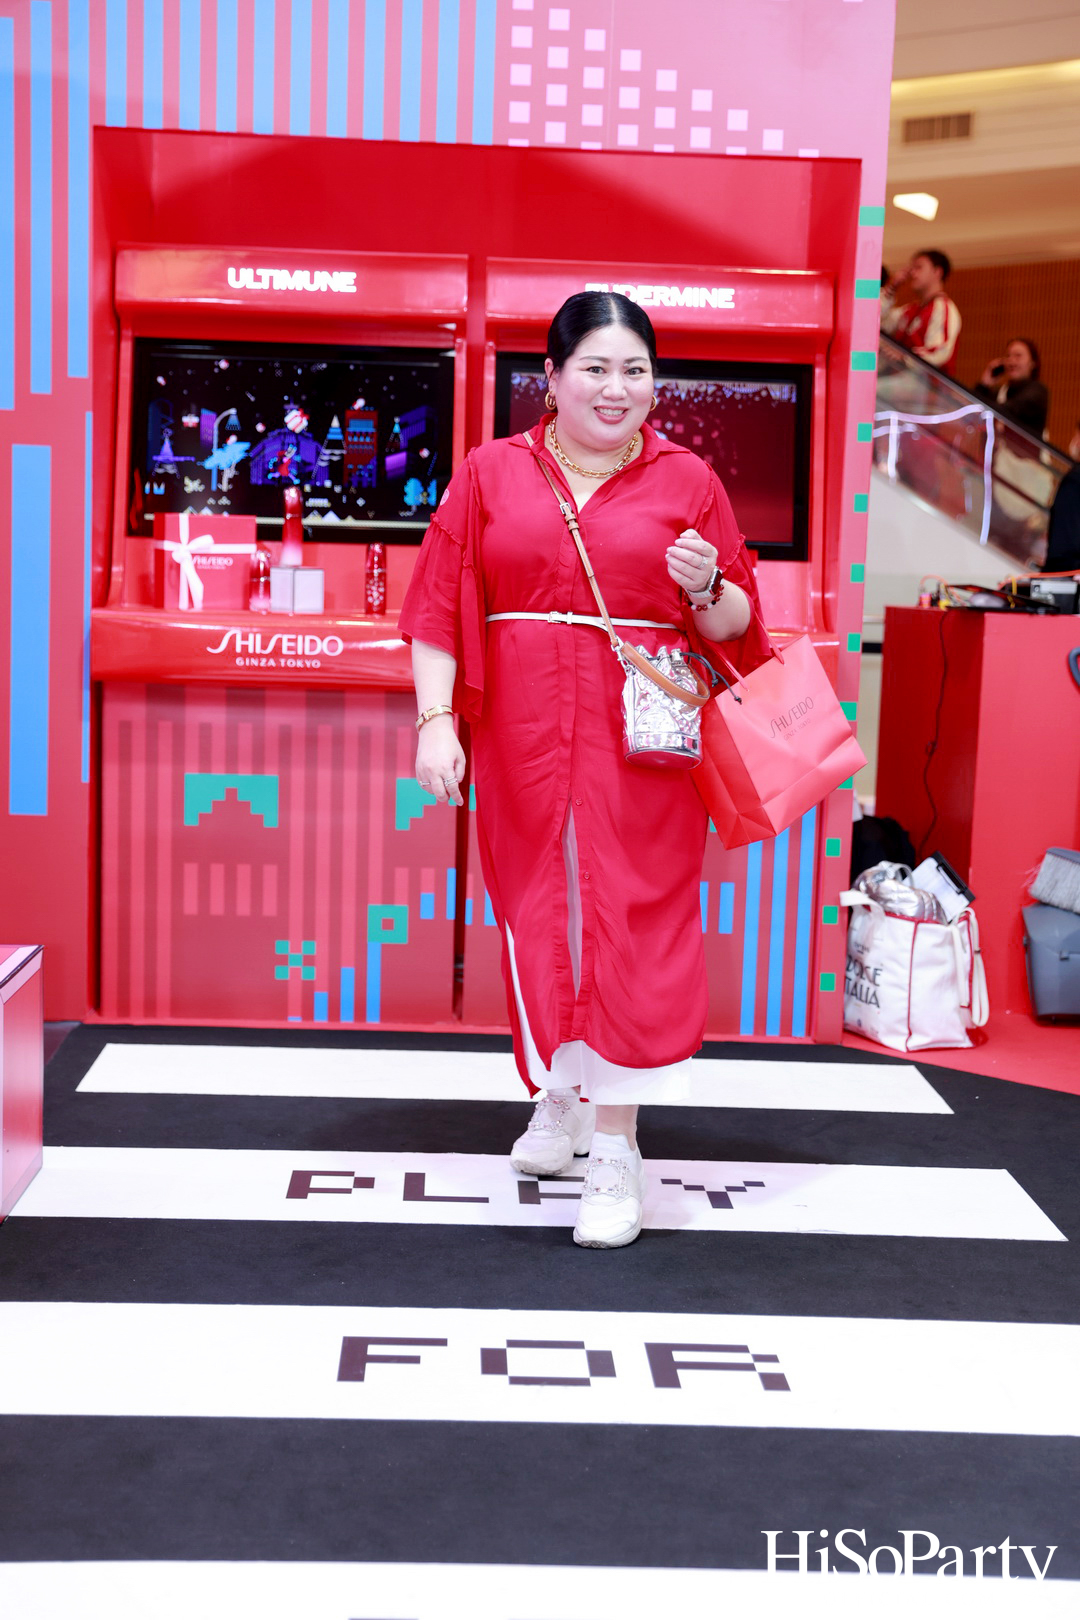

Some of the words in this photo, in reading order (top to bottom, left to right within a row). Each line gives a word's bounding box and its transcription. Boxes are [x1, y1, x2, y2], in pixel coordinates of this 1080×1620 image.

[227, 267, 357, 293] ULTIMUNE
[206, 629, 344, 656] SHISEIDO
[235, 657, 276, 667] GINZA
[279, 658, 321, 668] TOKYO
[770, 696, 814, 739] SHISEIDO
[844, 976, 880, 1009] TALIA
[337, 1336, 792, 1391] FOR
